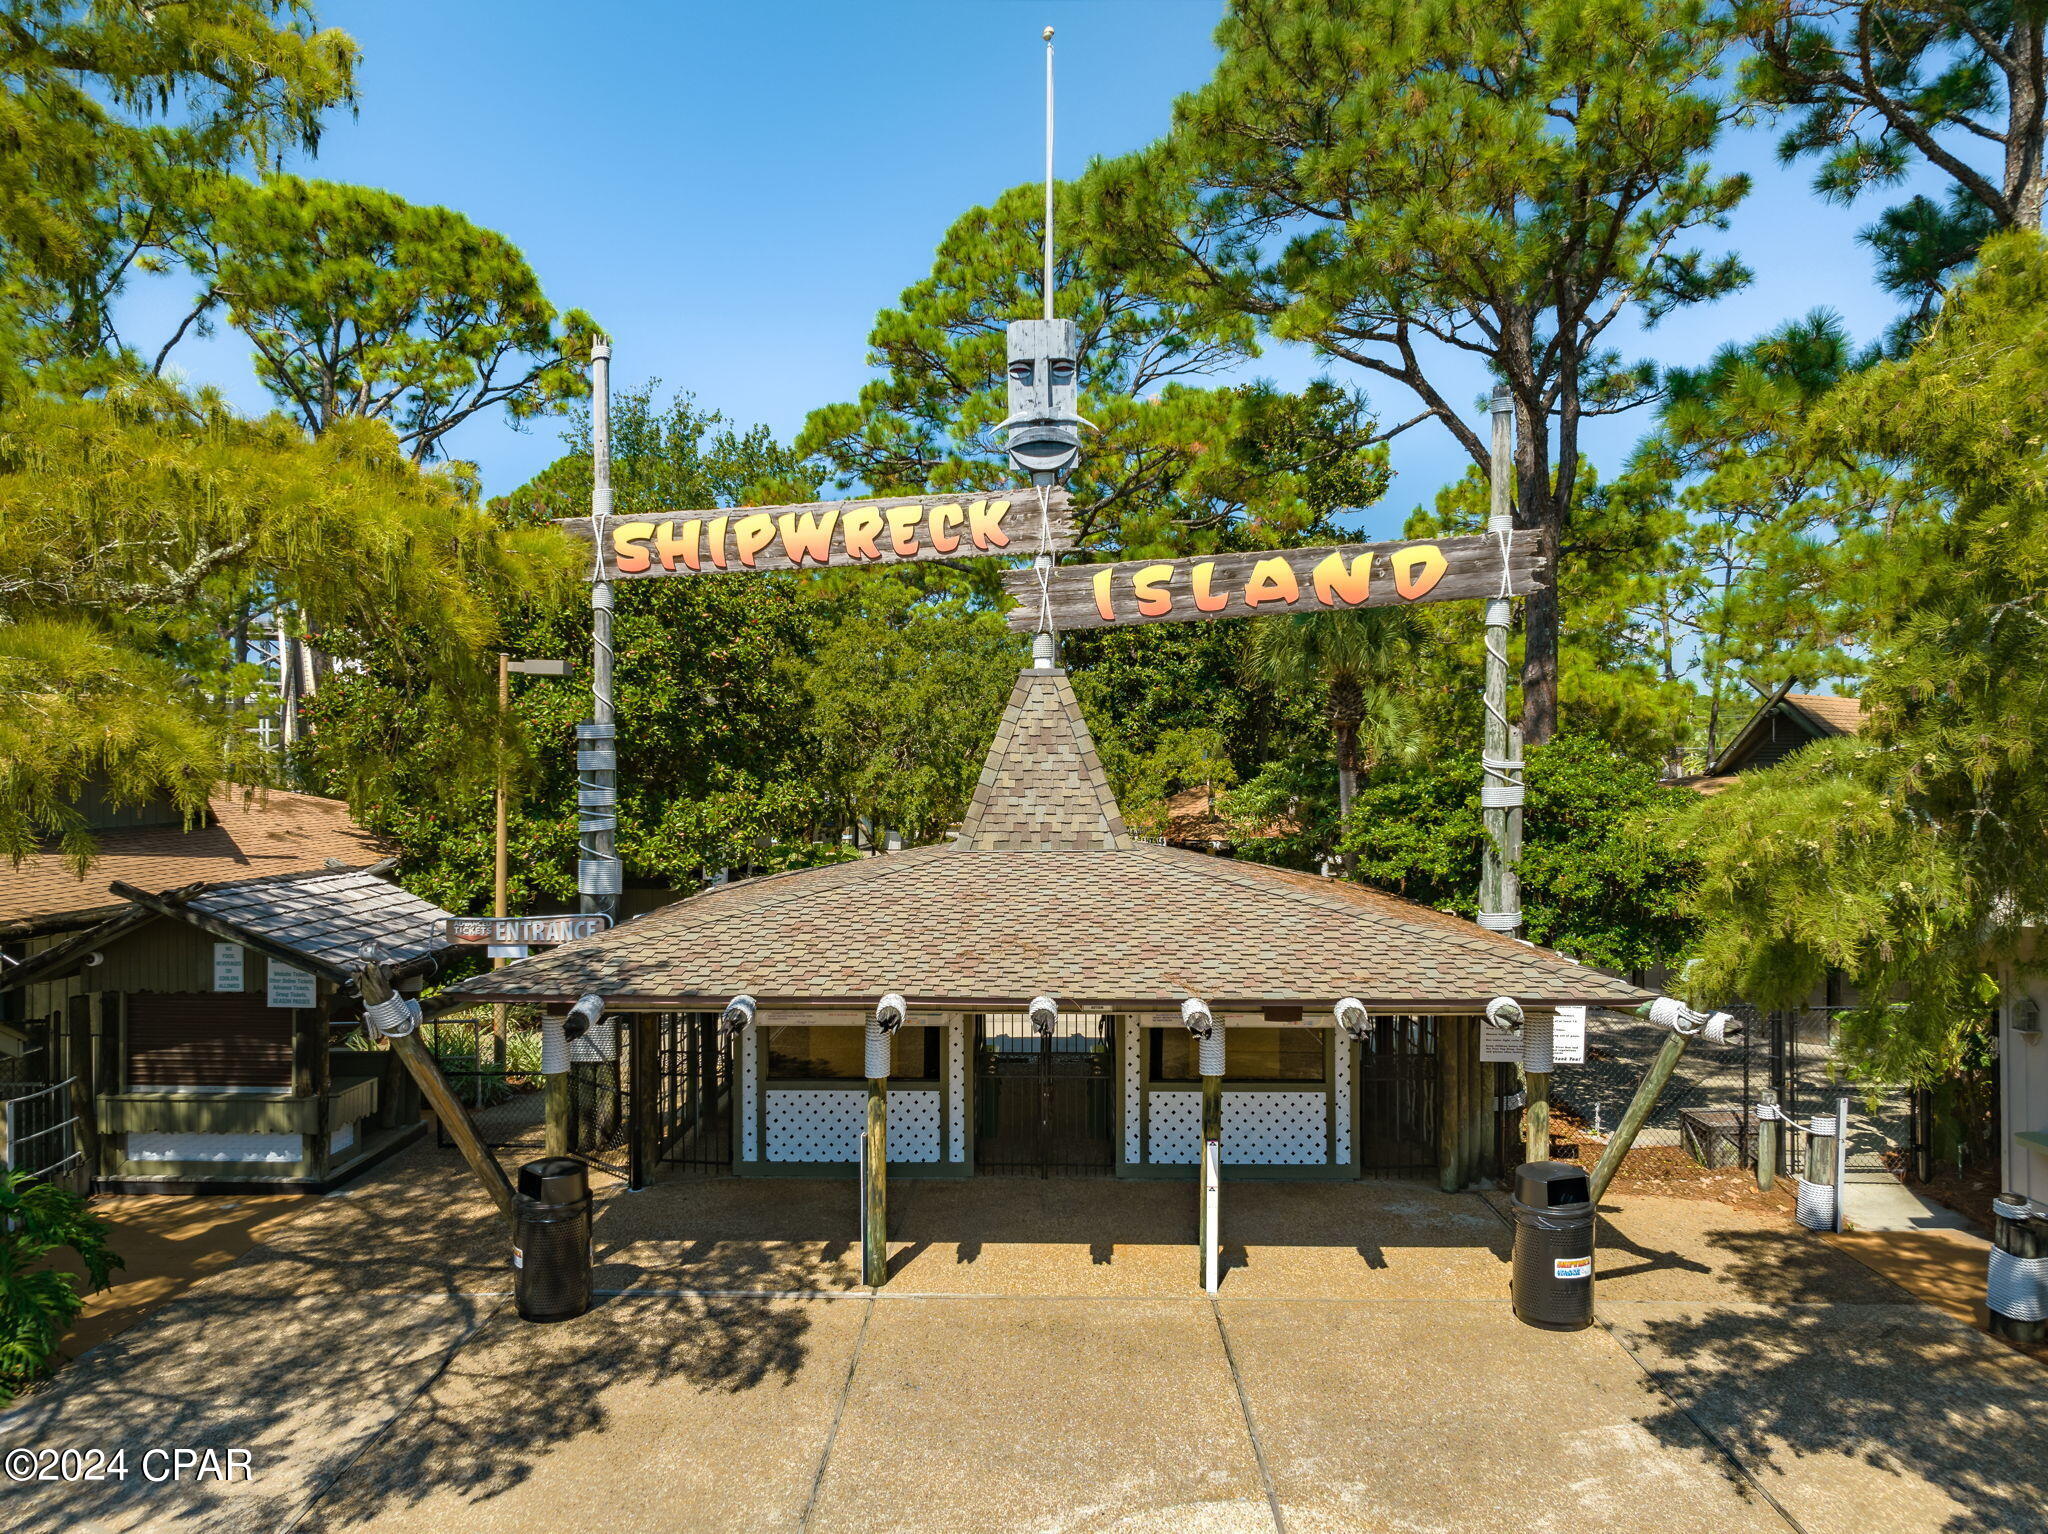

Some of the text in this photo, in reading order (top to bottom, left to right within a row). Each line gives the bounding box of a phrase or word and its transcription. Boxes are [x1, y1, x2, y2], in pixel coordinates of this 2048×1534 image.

[612, 499, 1012, 573] SHIPWRECK
[1092, 544, 1450, 620] ISLAND
[454, 926, 492, 936] TICKETS
[495, 920, 598, 942] ENTRANCE
